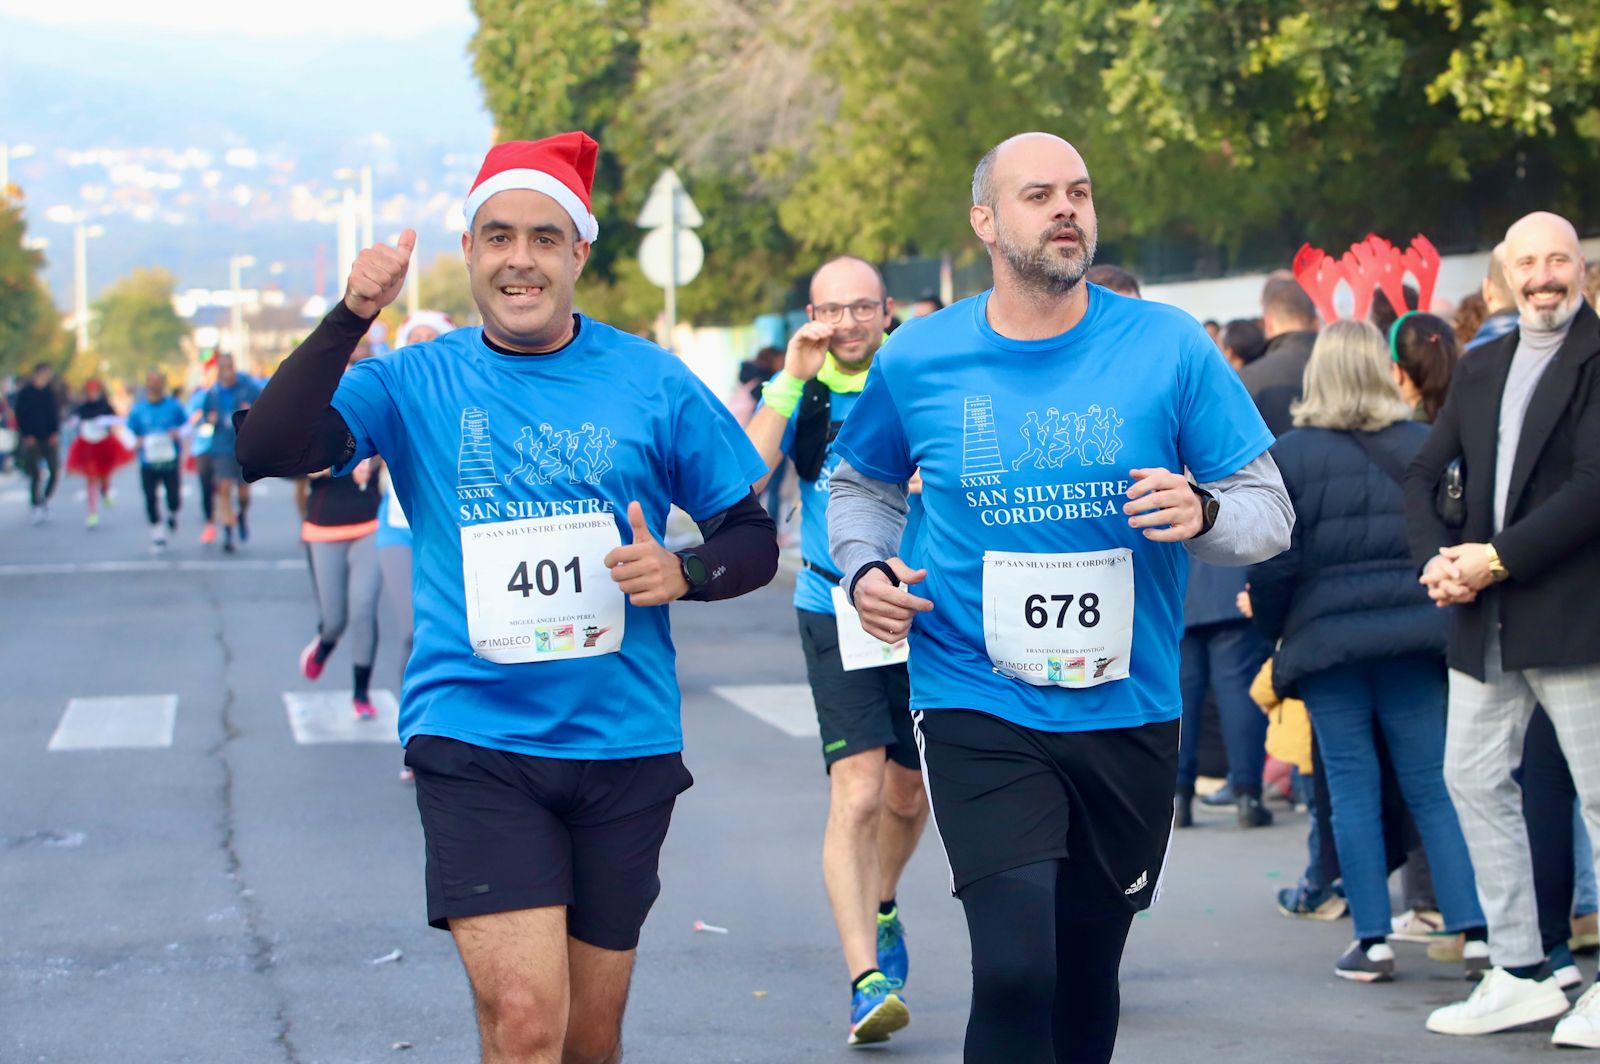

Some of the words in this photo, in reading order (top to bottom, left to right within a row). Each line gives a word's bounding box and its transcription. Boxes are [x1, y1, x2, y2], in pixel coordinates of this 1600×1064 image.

[960, 474, 1001, 488] XXXIX
[456, 487, 495, 500] XXXIX
[966, 488, 1008, 508] SAN
[1013, 480, 1129, 504] SILVESTRE
[460, 502, 501, 521] SAN
[506, 498, 615, 518] SILVESTRE
[981, 500, 1118, 526] CORDOBESA
[486, 530, 504, 538] SAN
[506, 524, 556, 537] SILVESTRE
[558, 520, 612, 531] CORDOBESA
[1007, 560, 1024, 568] SAN
[1026, 561, 1075, 569] SILVESTRE
[507, 556, 582, 598] 401
[1024, 592, 1101, 629] 678
[488, 635, 531, 647] IMDECO
[1080, 646, 1105, 654] POSTIGO
[1005, 661, 1043, 672] IMDECO
